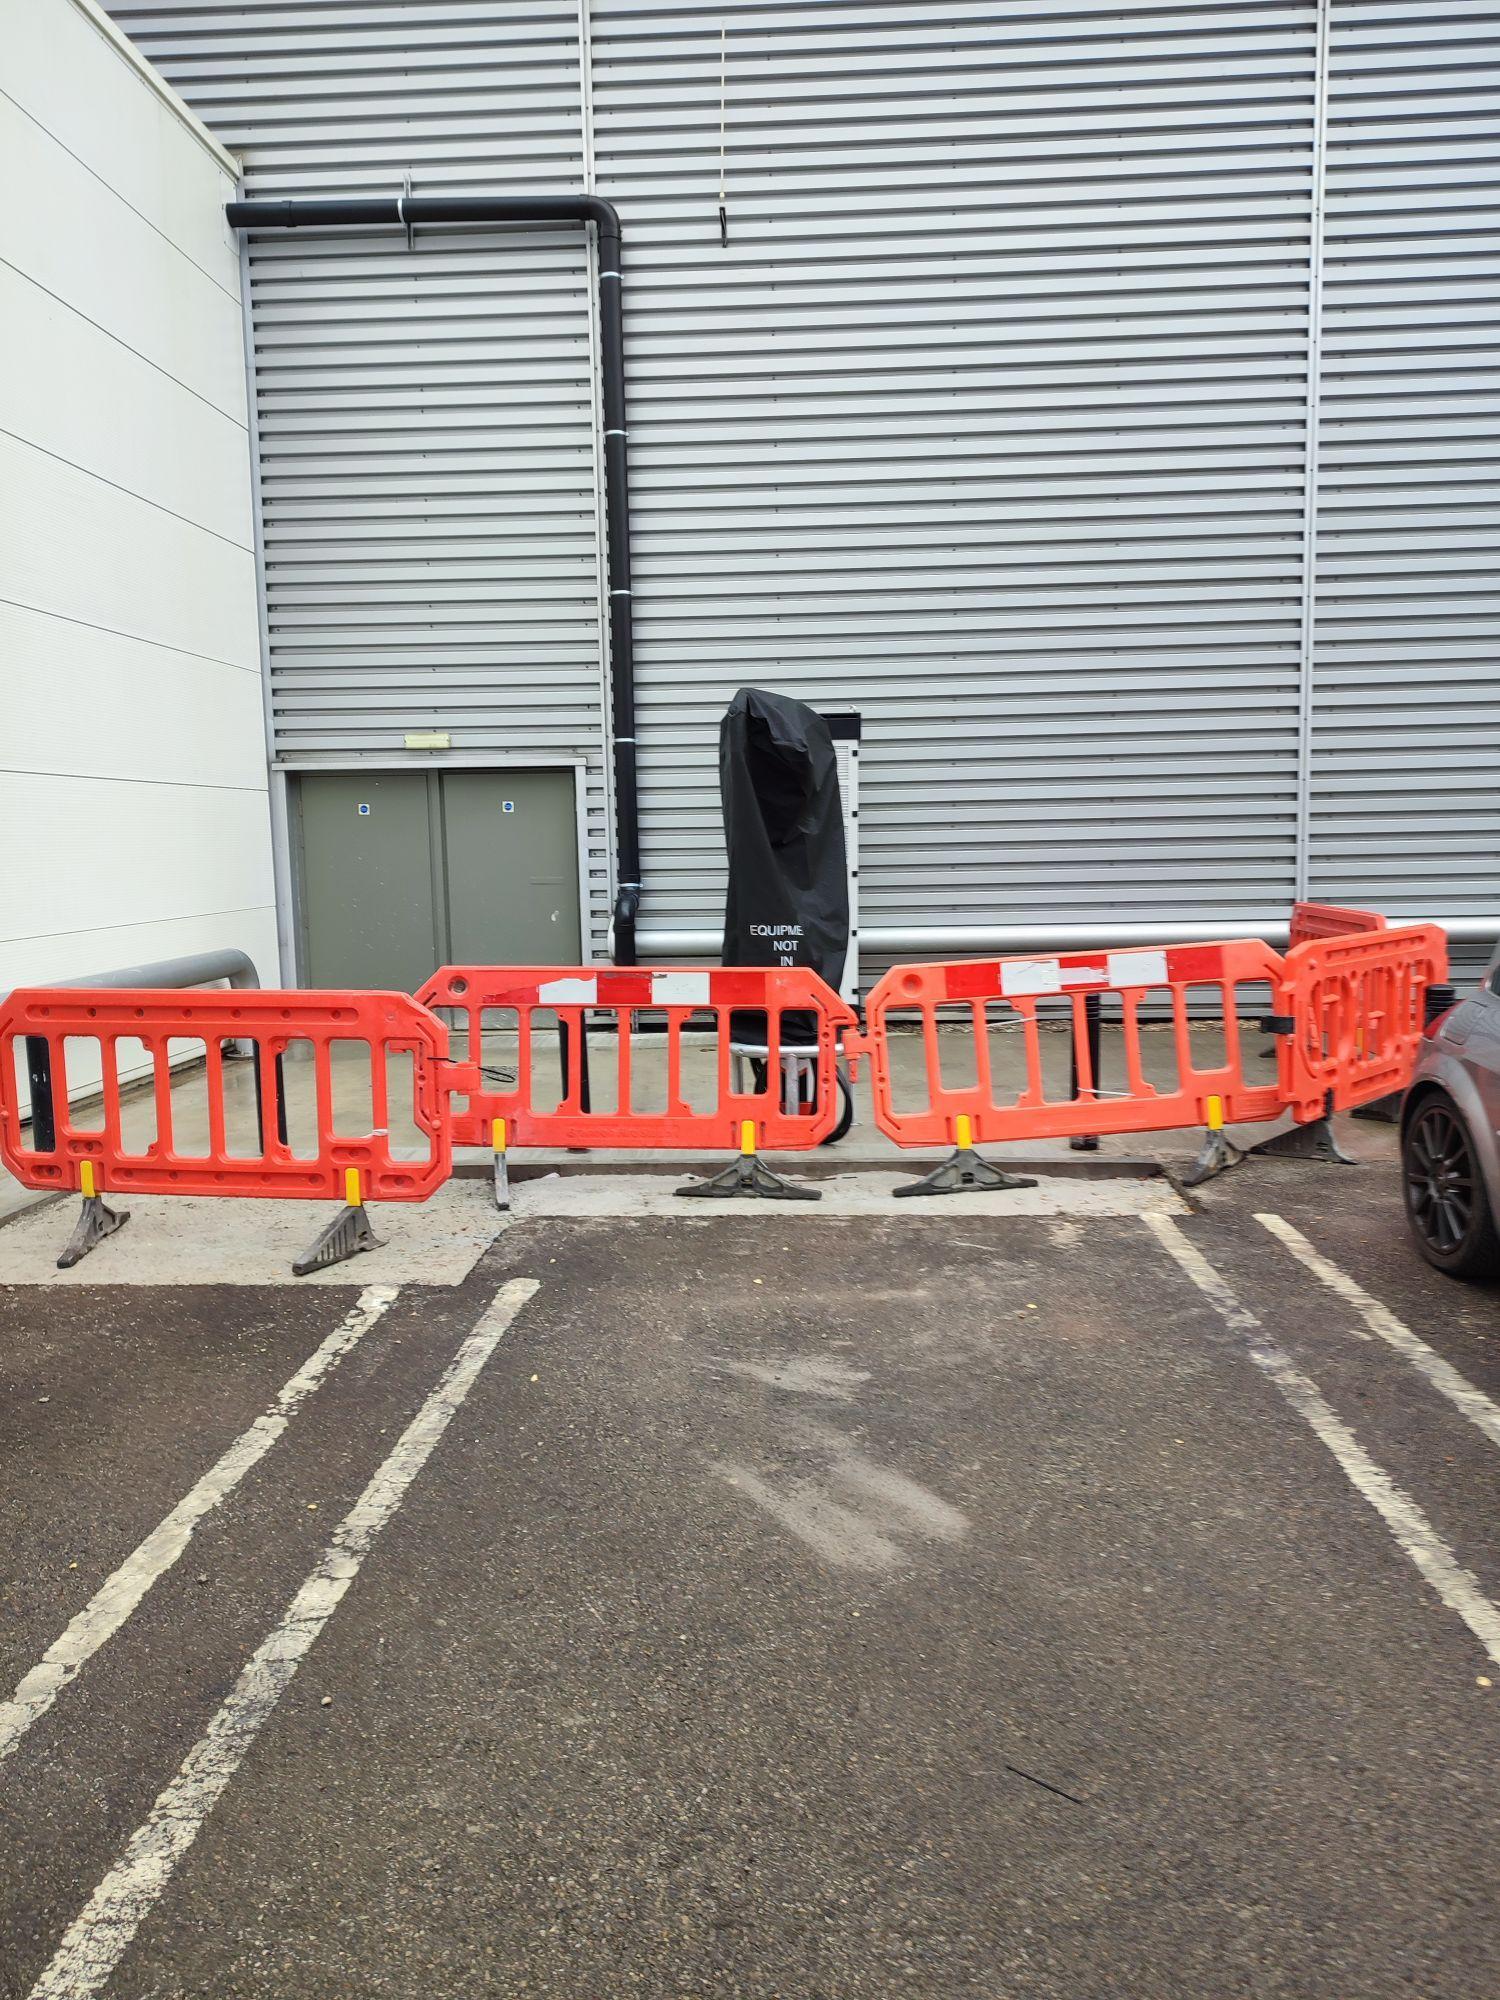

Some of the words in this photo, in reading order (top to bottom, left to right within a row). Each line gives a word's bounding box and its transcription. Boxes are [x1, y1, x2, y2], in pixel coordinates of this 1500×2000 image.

[749, 924, 804, 936] EQUIPME
[773, 940, 799, 951] NOT
[780, 956, 793, 966] IN
